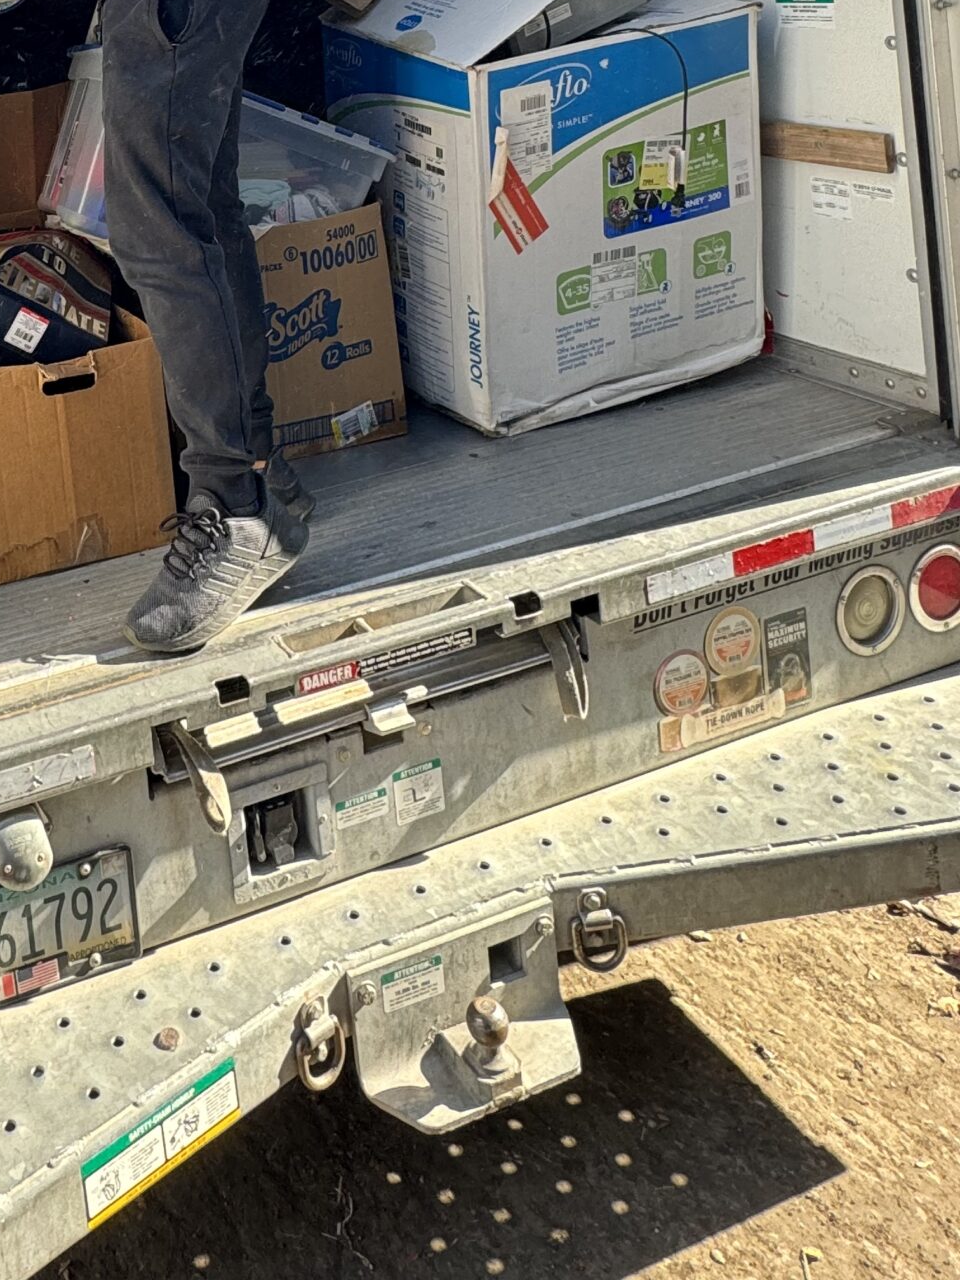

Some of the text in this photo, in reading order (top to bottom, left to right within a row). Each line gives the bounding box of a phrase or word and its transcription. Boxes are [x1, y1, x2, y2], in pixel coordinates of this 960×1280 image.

[326, 223, 355, 242] 54000
[42, 246, 67, 276] TO
[300, 239, 355, 274] 10060
[358, 235, 376, 260] 00
[565, 284, 589, 298] 4-35
[268, 290, 325, 346] Scott
[287, 330, 312, 354] 1000
[326, 340, 371, 365] 12 Rolls
[633, 601, 687, 629] Don't
[693, 580, 755, 605] Forget
[808, 542, 874, 573] Moving
[767, 622, 806, 640] MAXIMUM
[768, 630, 806, 649] SECURITY
[303, 664, 353, 692] DANGER
[745, 699, 765, 716] ROPE
[400, 761, 433, 779] ATTENTION
[344, 791, 379, 808] ATTENTION
[394, 960, 431, 980] ATTENTION
